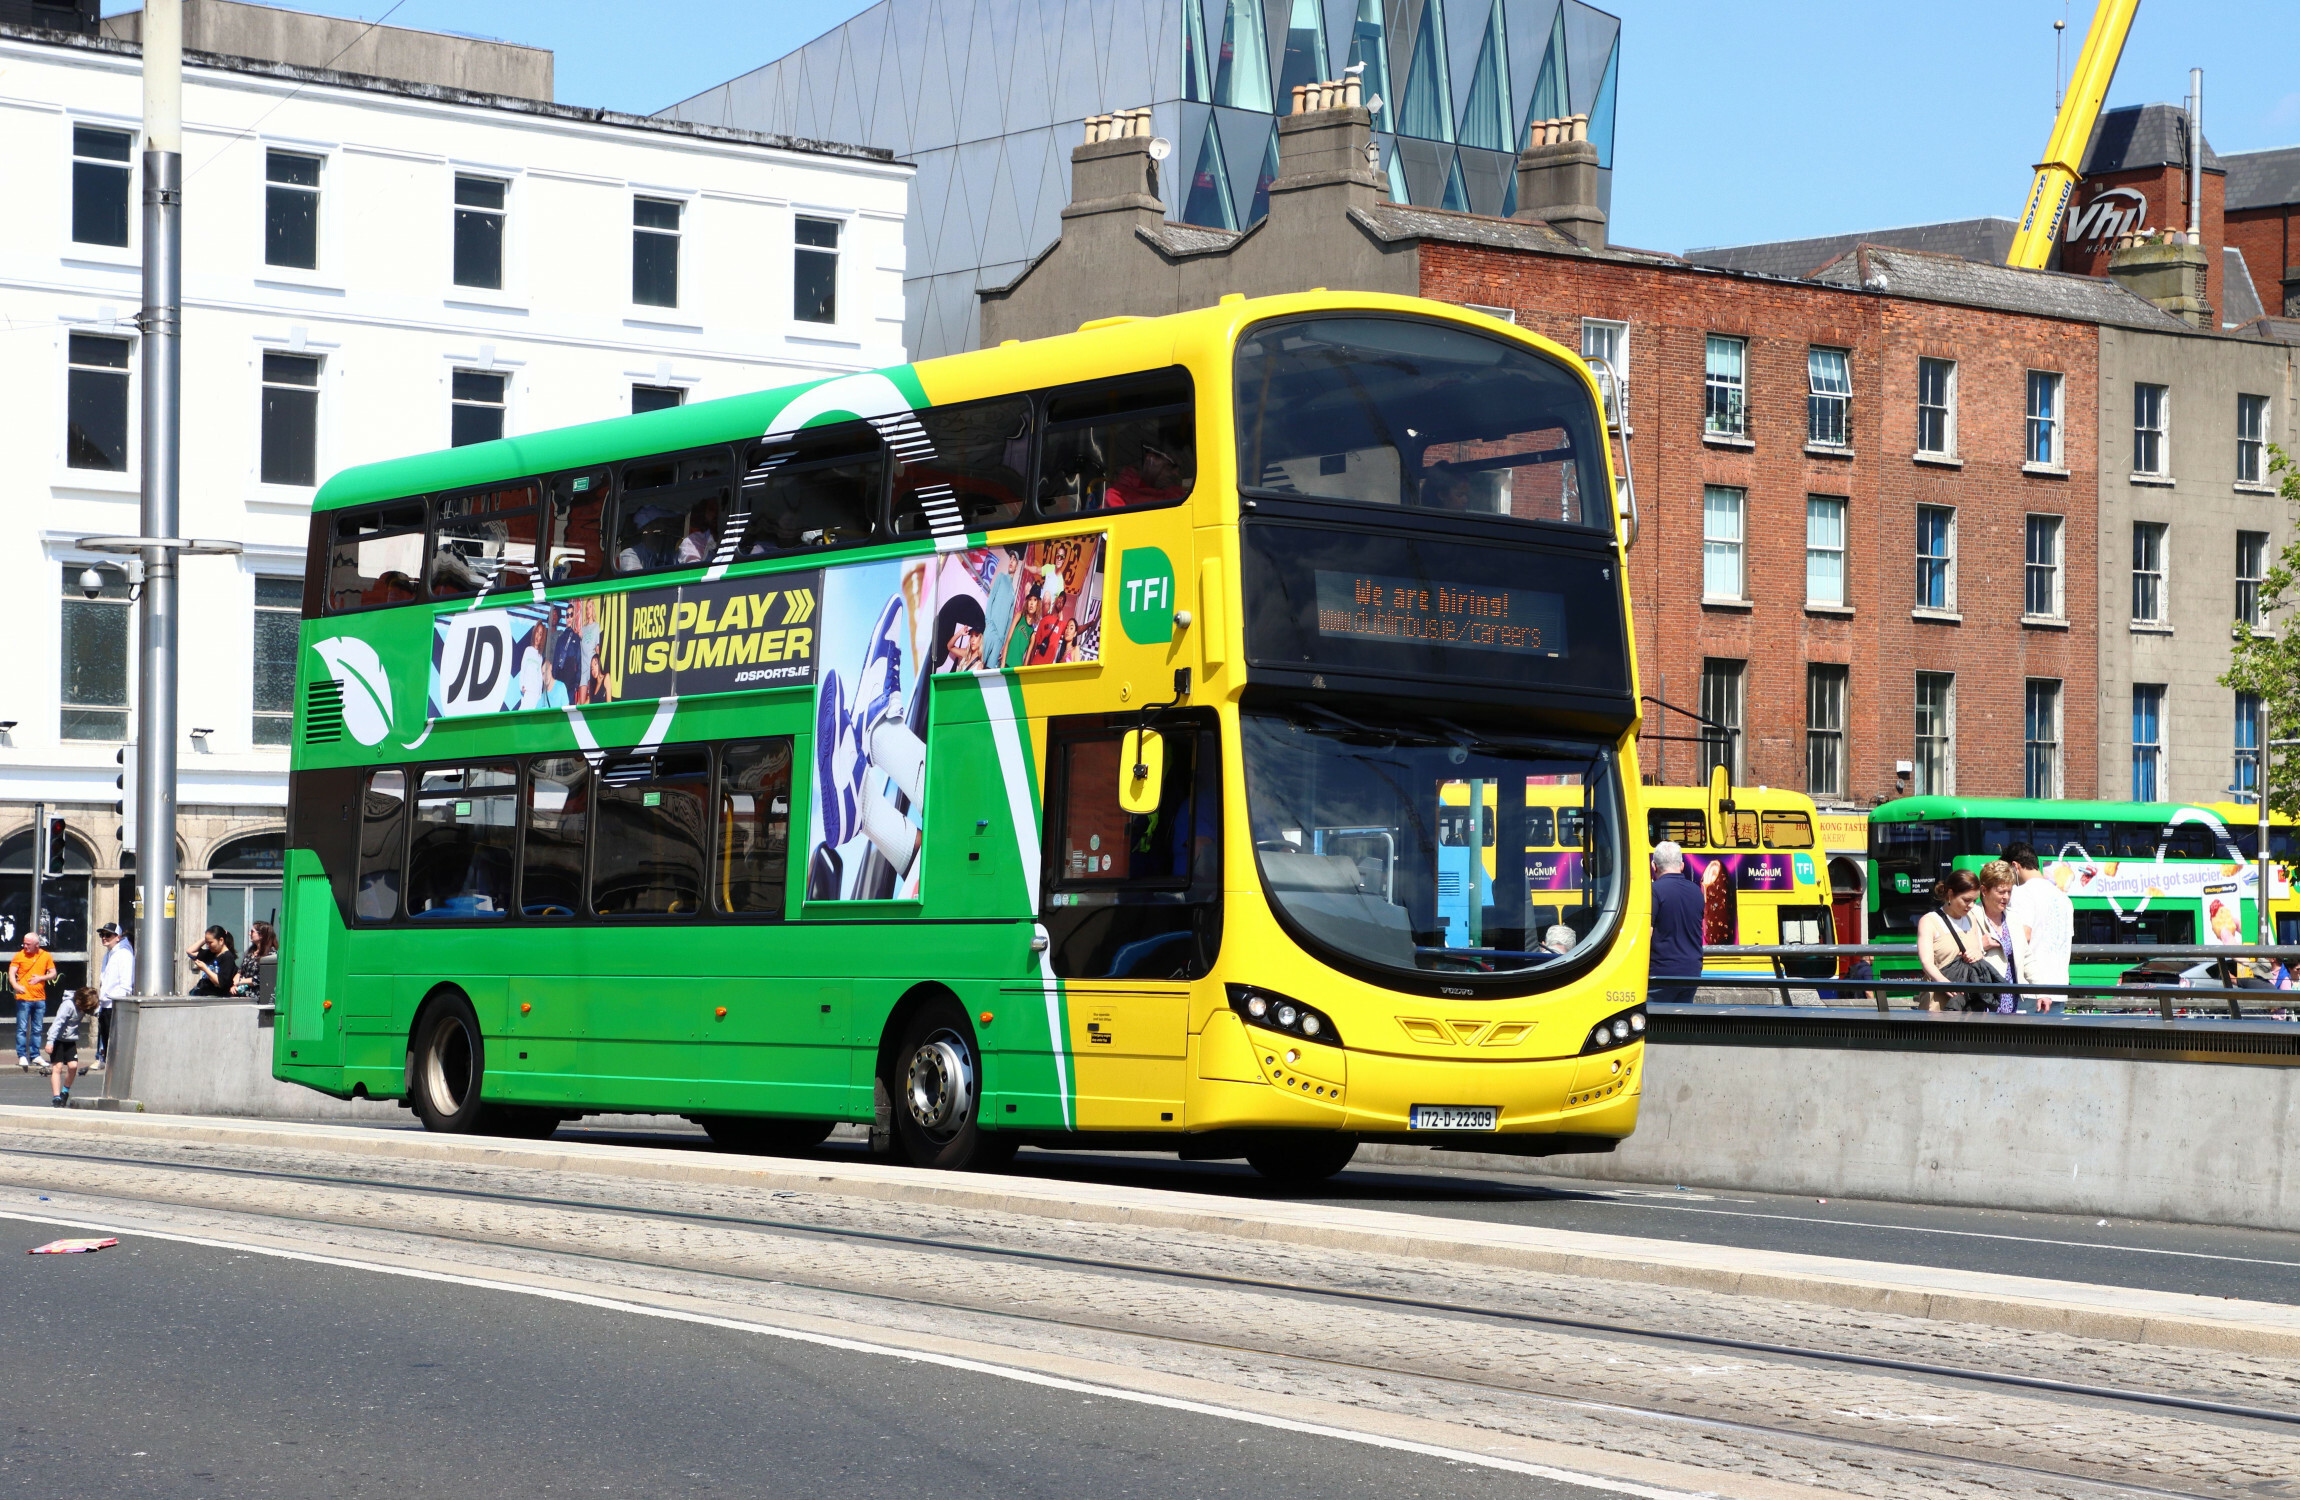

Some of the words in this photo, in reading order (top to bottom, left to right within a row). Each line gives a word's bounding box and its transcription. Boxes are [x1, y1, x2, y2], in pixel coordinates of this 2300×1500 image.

[2047, 180, 2072, 242] KAVANAGH
[2066, 199, 2141, 242] Vhi
[1126, 576, 1168, 612] TFI
[1355, 579, 1383, 606] We
[1393, 588, 1429, 611] are
[1439, 587, 1509, 618] hiring!
[632, 608, 666, 641] PRESS
[668, 590, 778, 631] PLAY
[629, 648, 644, 675] ON
[644, 628, 813, 673] SUMMER
[447, 625, 504, 704] JD
[734, 665, 810, 683] JDSPORTS.IE
[1820, 822, 1843, 832] KONG
[1844, 822, 1868, 832] TASTE
[1822, 833, 1846, 843] AKERY
[1748, 867, 1782, 877] MAGNUM
[1796, 862, 1813, 875] TFI
[1897, 879, 1910, 887] TFI
[2097, 875, 2139, 893] Sharing
[2139, 873, 2161, 892] just
[2163, 873, 2180, 890] got
[2183, 869, 2223, 885] saucier.
[1440, 986, 1474, 996] VOLVO
[1606, 990, 1636, 1003] SG355
[1421, 1111, 1492, 1127] 172-D-22309
